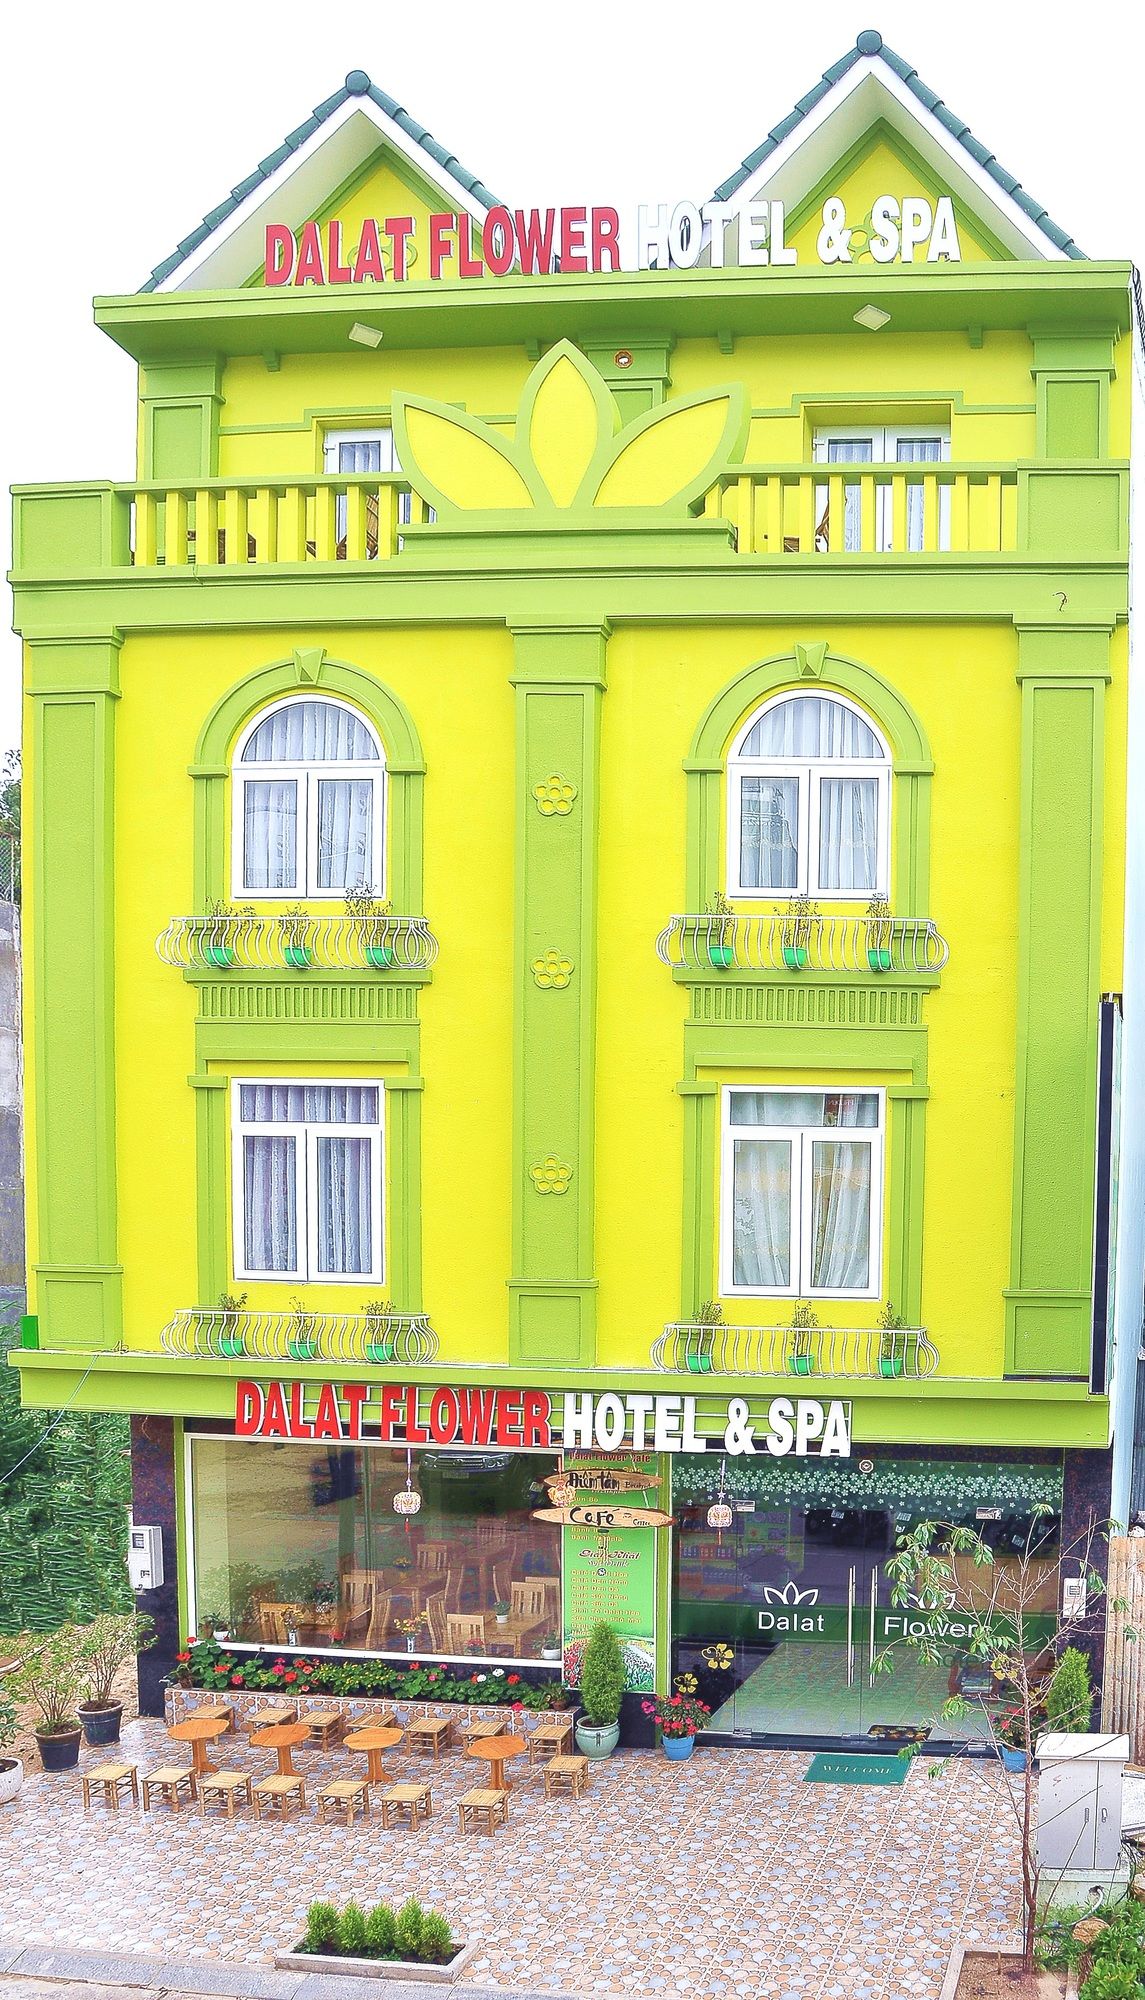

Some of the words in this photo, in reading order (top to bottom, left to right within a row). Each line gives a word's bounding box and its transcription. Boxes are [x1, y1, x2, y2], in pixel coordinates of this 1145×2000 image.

[264, 215, 415, 287] DALAT
[429, 205, 621, 280] FLOWER
[636, 199, 798, 272] HOTEL
[816, 195, 852, 263] &
[870, 194, 962, 264] SPA
[235, 1380, 368, 1441] DALAT
[379, 1384, 552, 1448] FLOWER
[563, 1392, 707, 1454] HOTEL
[724, 1396, 759, 1456] &
[766, 1396, 852, 1458] SPA
[758, 1611, 825, 1633] Dalat
[884, 1615, 979, 1638] Flower
